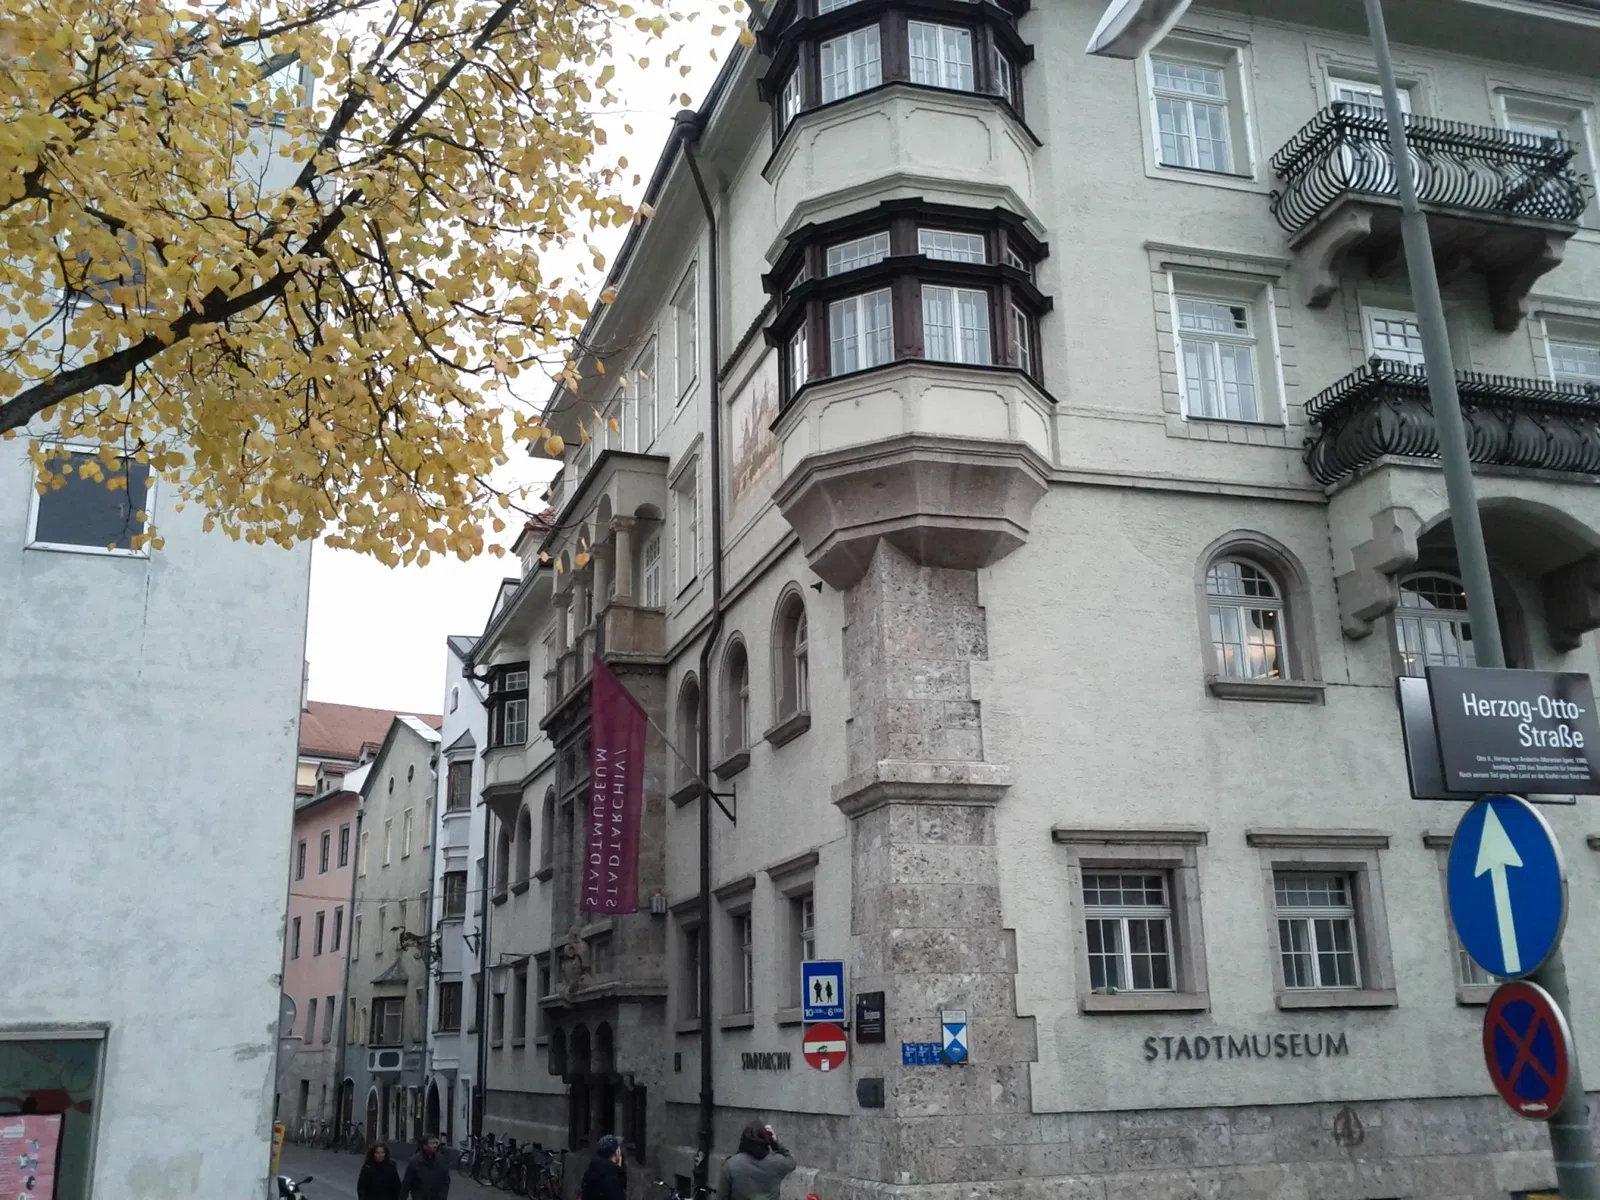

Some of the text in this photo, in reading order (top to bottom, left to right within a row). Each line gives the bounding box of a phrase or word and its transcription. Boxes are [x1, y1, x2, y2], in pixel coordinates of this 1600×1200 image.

[1462, 692, 1586, 723] Herzog-Otto-
[1518, 723, 1585, 748] Straße
[1144, 1033, 1349, 1061] STADTMUSEUM
